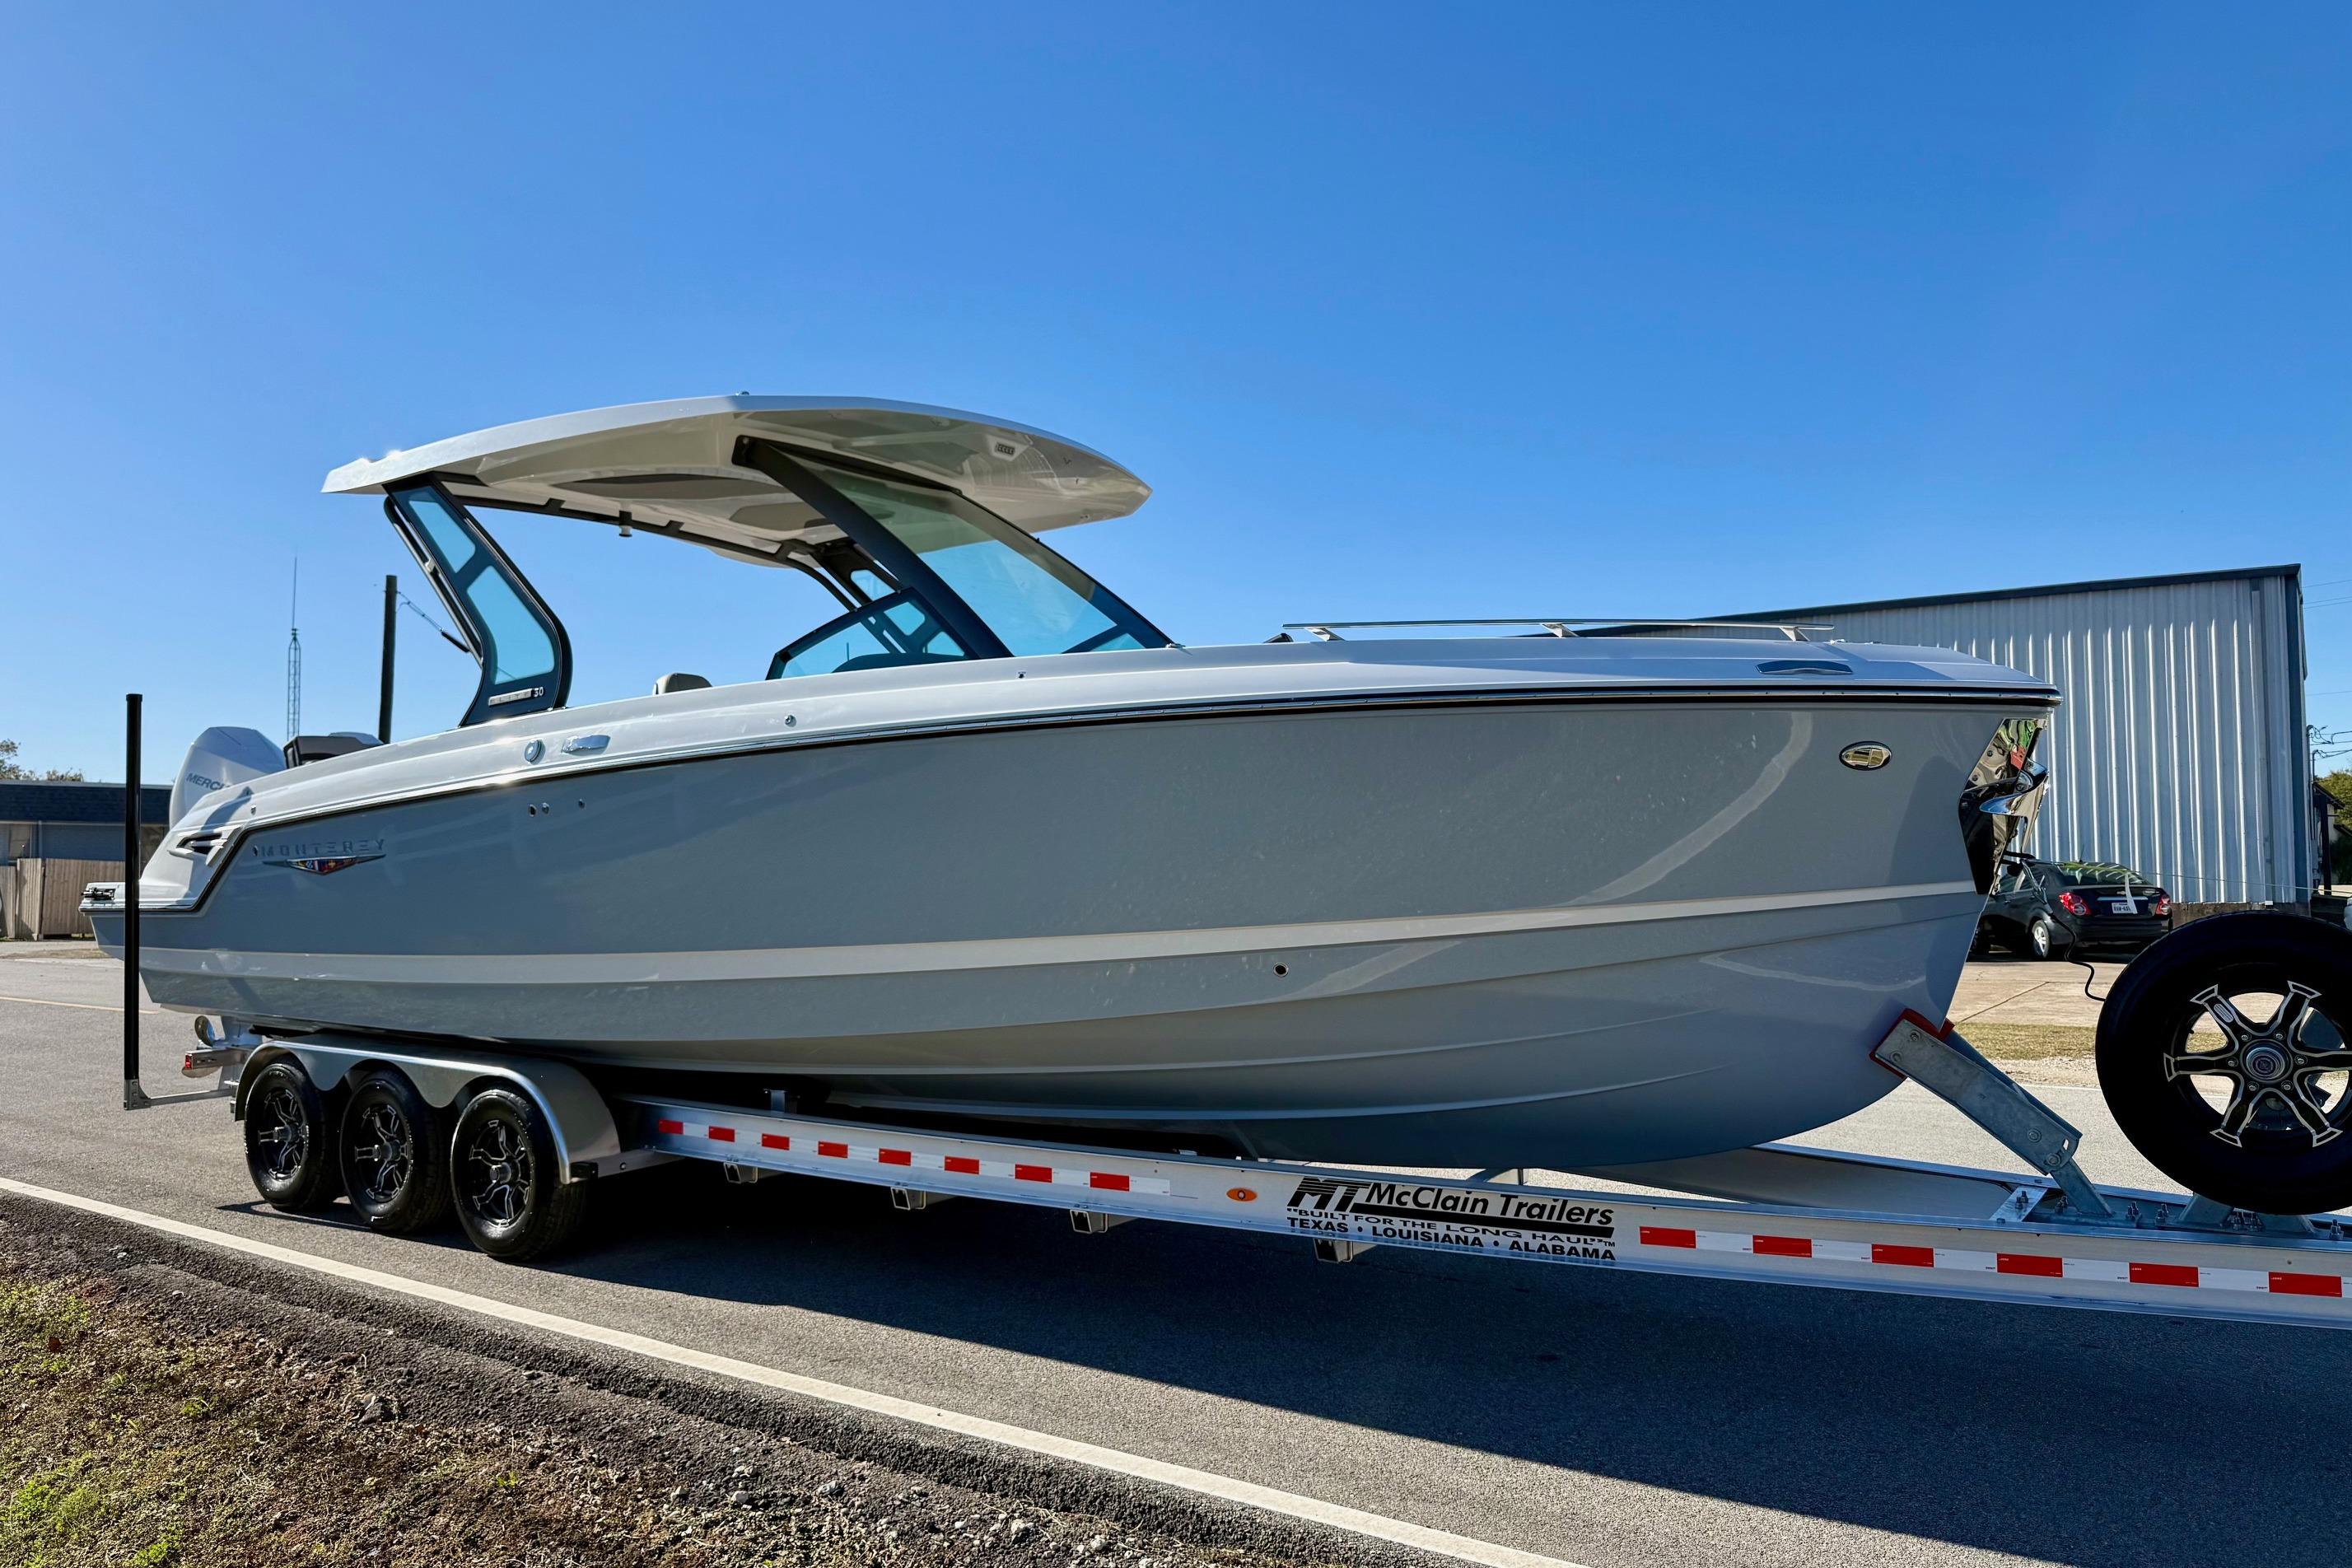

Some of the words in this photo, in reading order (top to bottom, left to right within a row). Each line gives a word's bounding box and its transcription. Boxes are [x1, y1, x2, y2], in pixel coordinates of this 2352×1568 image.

[261, 838, 385, 857] MONTEREY
[1365, 1183, 1489, 1215] McClain
[1500, 1194, 1615, 1225] Trailers
[1287, 1216, 1349, 1233] TEXAS
[1371, 1225, 1484, 1248] LOUISIANA
[1509, 1240, 1616, 1261] ALABAMA
[1354, 1215, 1394, 1225] FOR
[1399, 1220, 1437, 1230] THE
[1445, 1225, 1523, 1239] LONG
